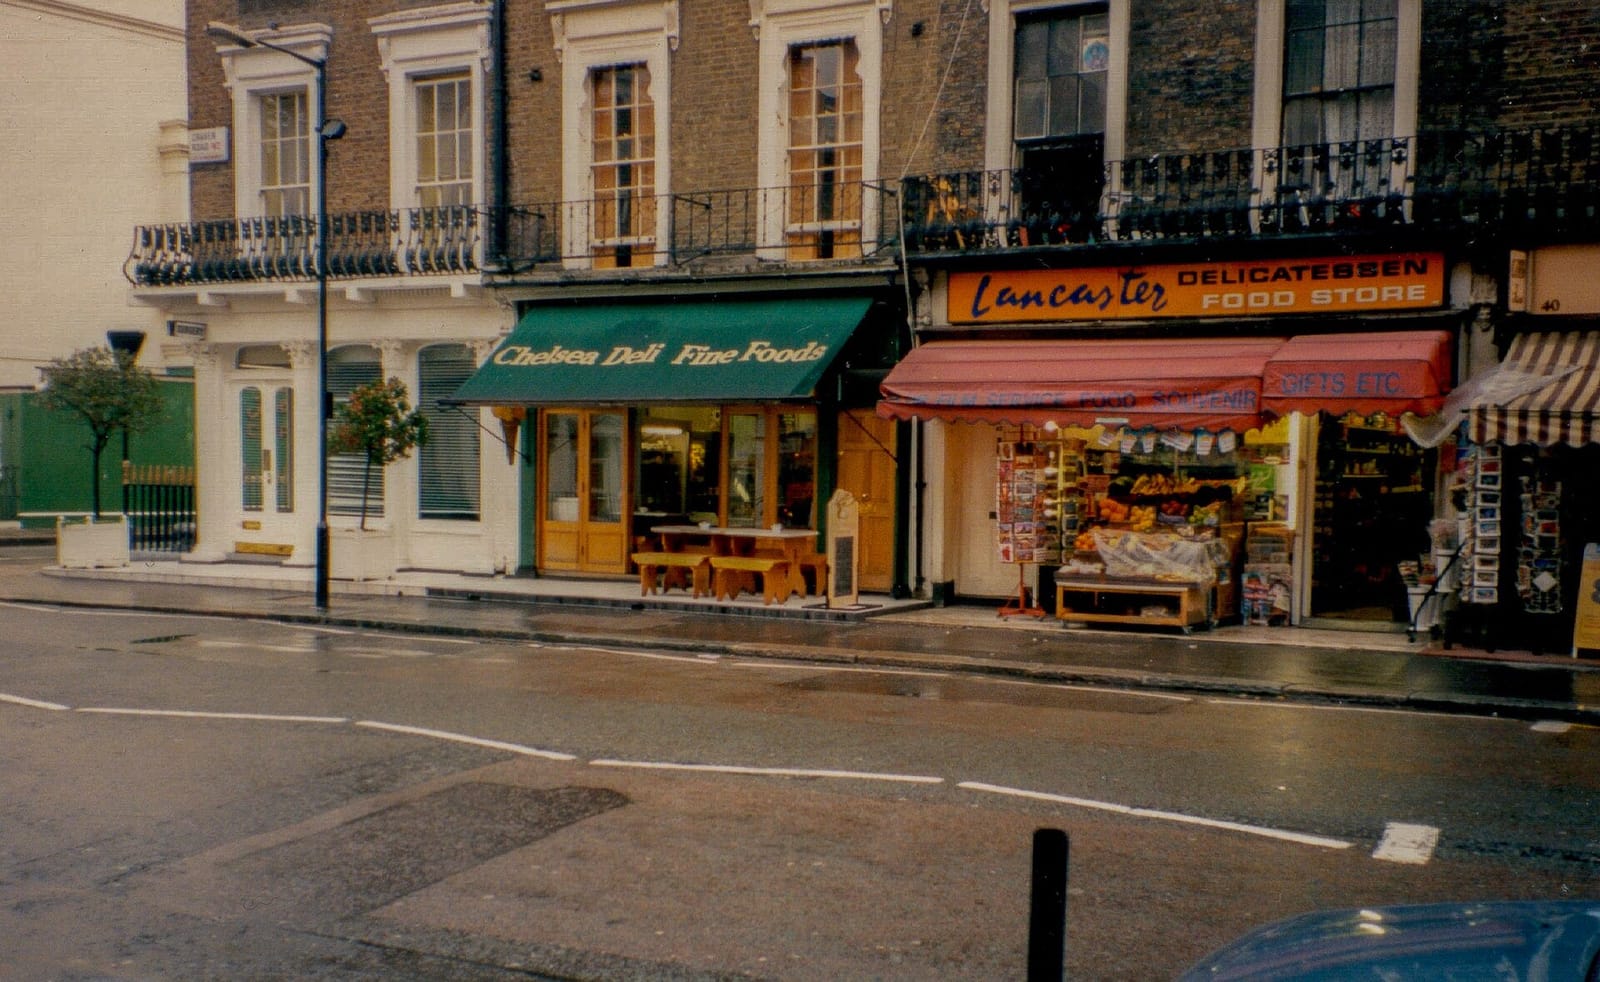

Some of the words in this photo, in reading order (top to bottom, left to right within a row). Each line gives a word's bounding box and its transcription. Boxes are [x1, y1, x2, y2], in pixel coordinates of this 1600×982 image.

[1178, 258, 1428, 286] DELICATESSEN
[971, 272, 1168, 318] Lancaster
[1202, 291, 1295, 309] FOOD
[1311, 285, 1426, 305] STORE
[1540, 298, 1560, 311] 40
[493, 345, 599, 366] Chelsea
[600, 343, 666, 366] Deli
[671, 344, 738, 365] Fine
[738, 341, 827, 362] Foods
[1281, 372, 1345, 395] GIFTS
[1080, 390, 1136, 408] FOOD
[1152, 389, 1258, 410] SOUVENIR
